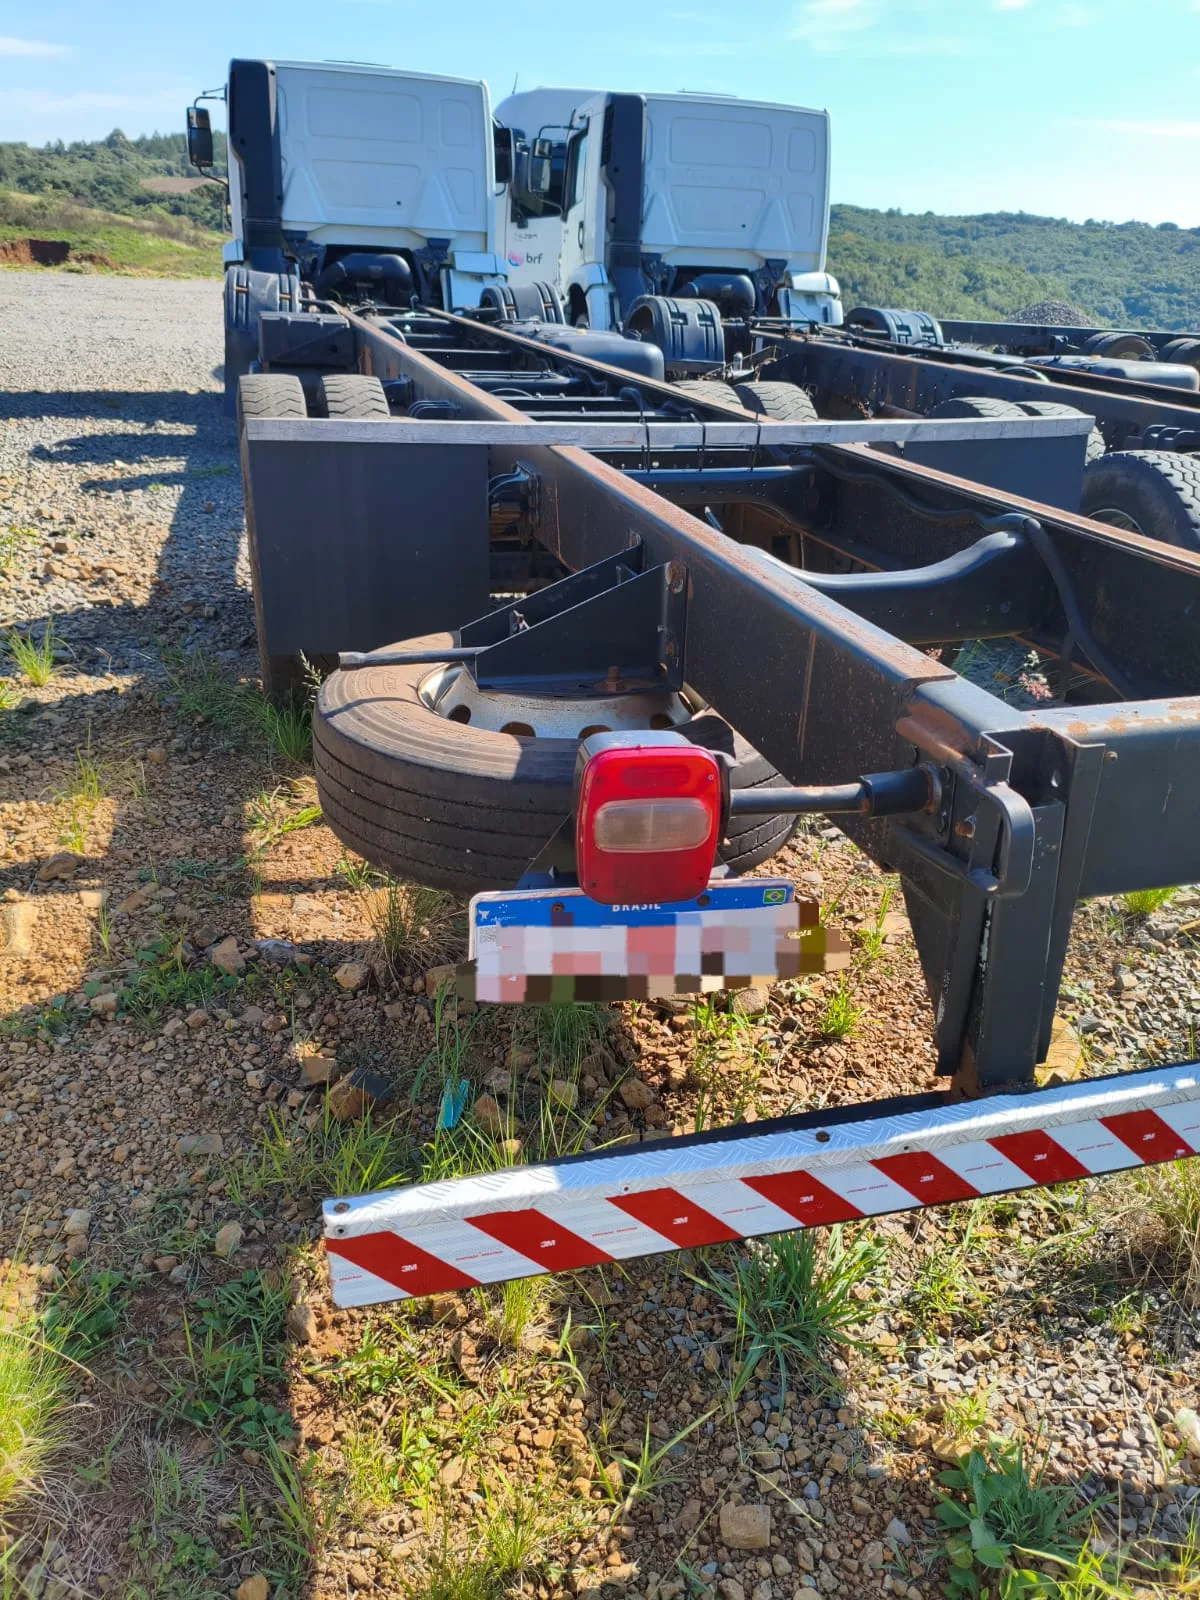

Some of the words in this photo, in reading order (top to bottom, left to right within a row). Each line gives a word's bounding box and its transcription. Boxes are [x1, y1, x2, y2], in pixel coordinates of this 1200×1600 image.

[526, 252, 543, 264] brf
[1143, 1133, 1155, 1141] 3M
[1034, 1153, 1047, 1161] 3M
[920, 1174, 933, 1183] 3M
[800, 1195, 813, 1204] 3M
[673, 1216, 688, 1225] 3M
[541, 1239, 556, 1248] 3M
[402, 1263, 417, 1273] 3M
